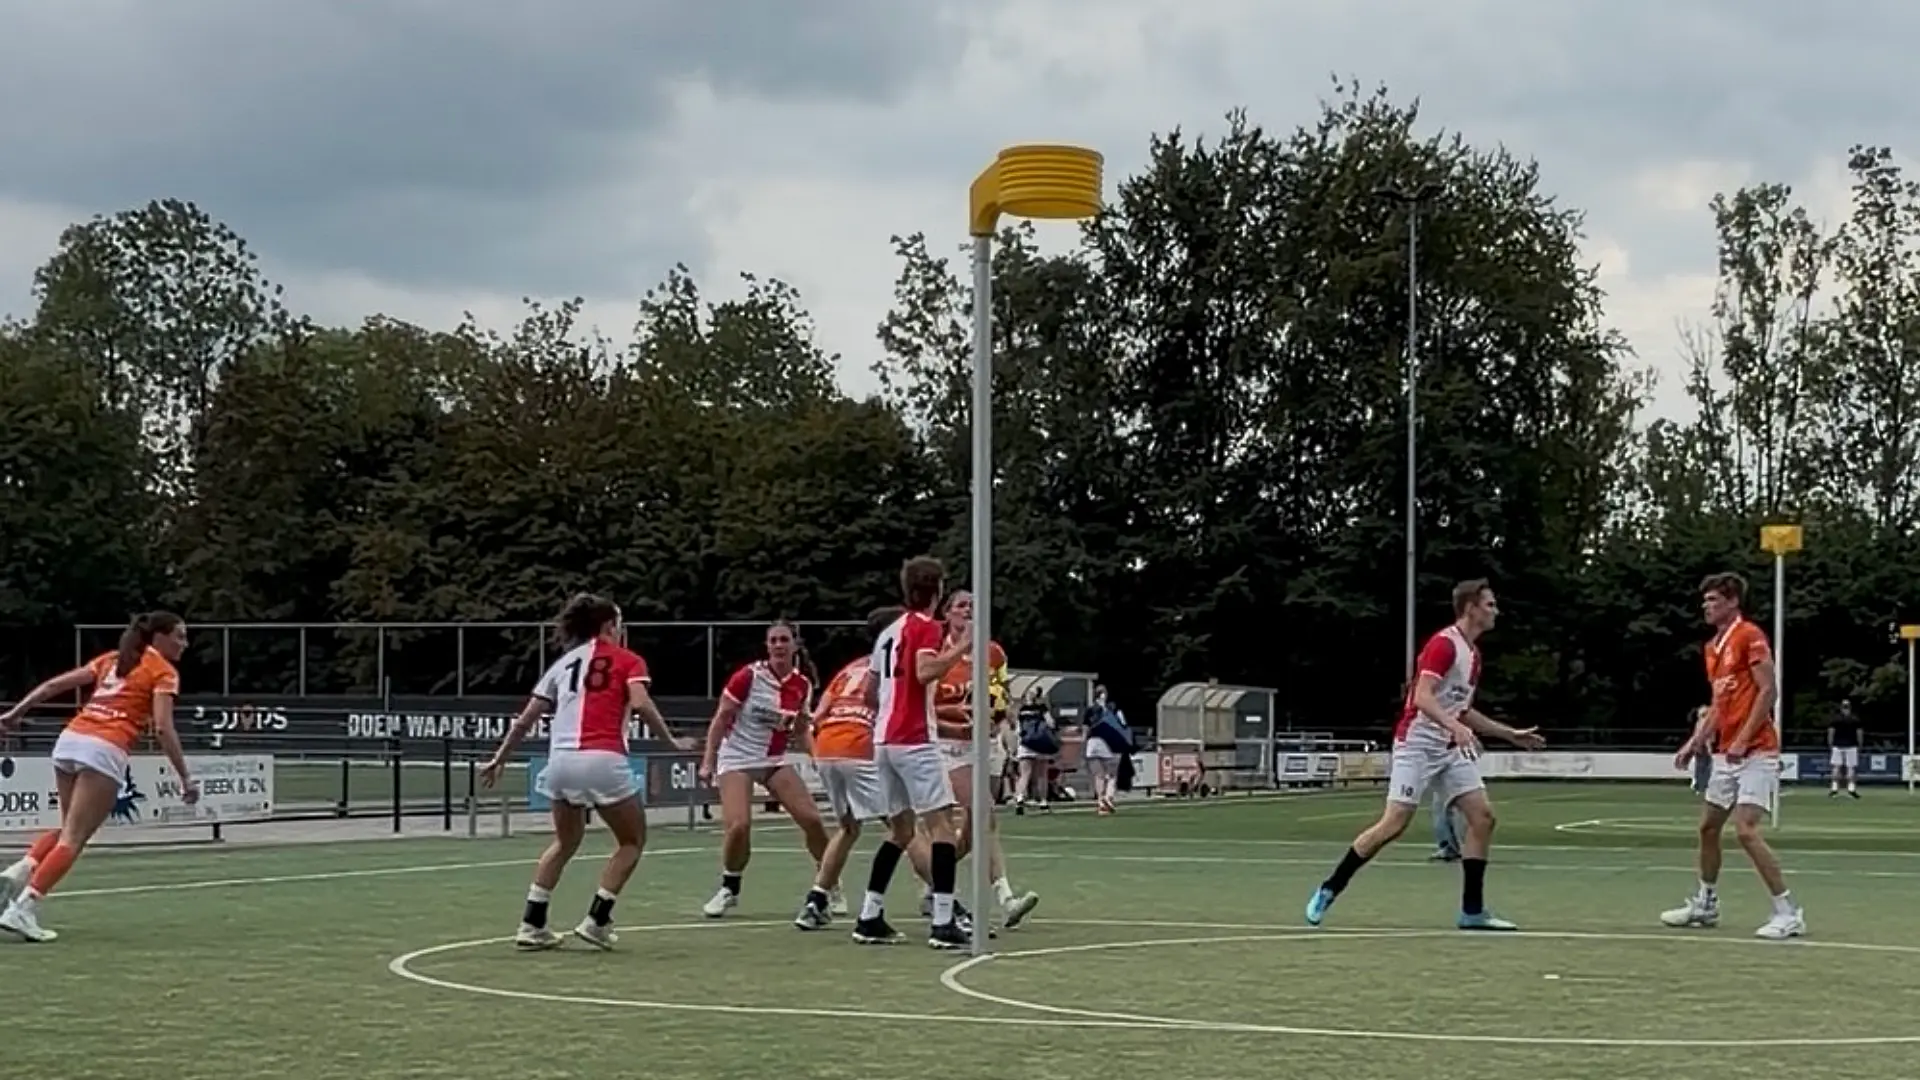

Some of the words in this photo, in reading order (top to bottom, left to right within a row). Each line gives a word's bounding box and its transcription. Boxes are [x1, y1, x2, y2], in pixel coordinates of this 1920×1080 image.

[565, 656, 613, 693] 18
[348, 714, 400, 737] DOEN
[406, 716, 466, 738] WAAR
